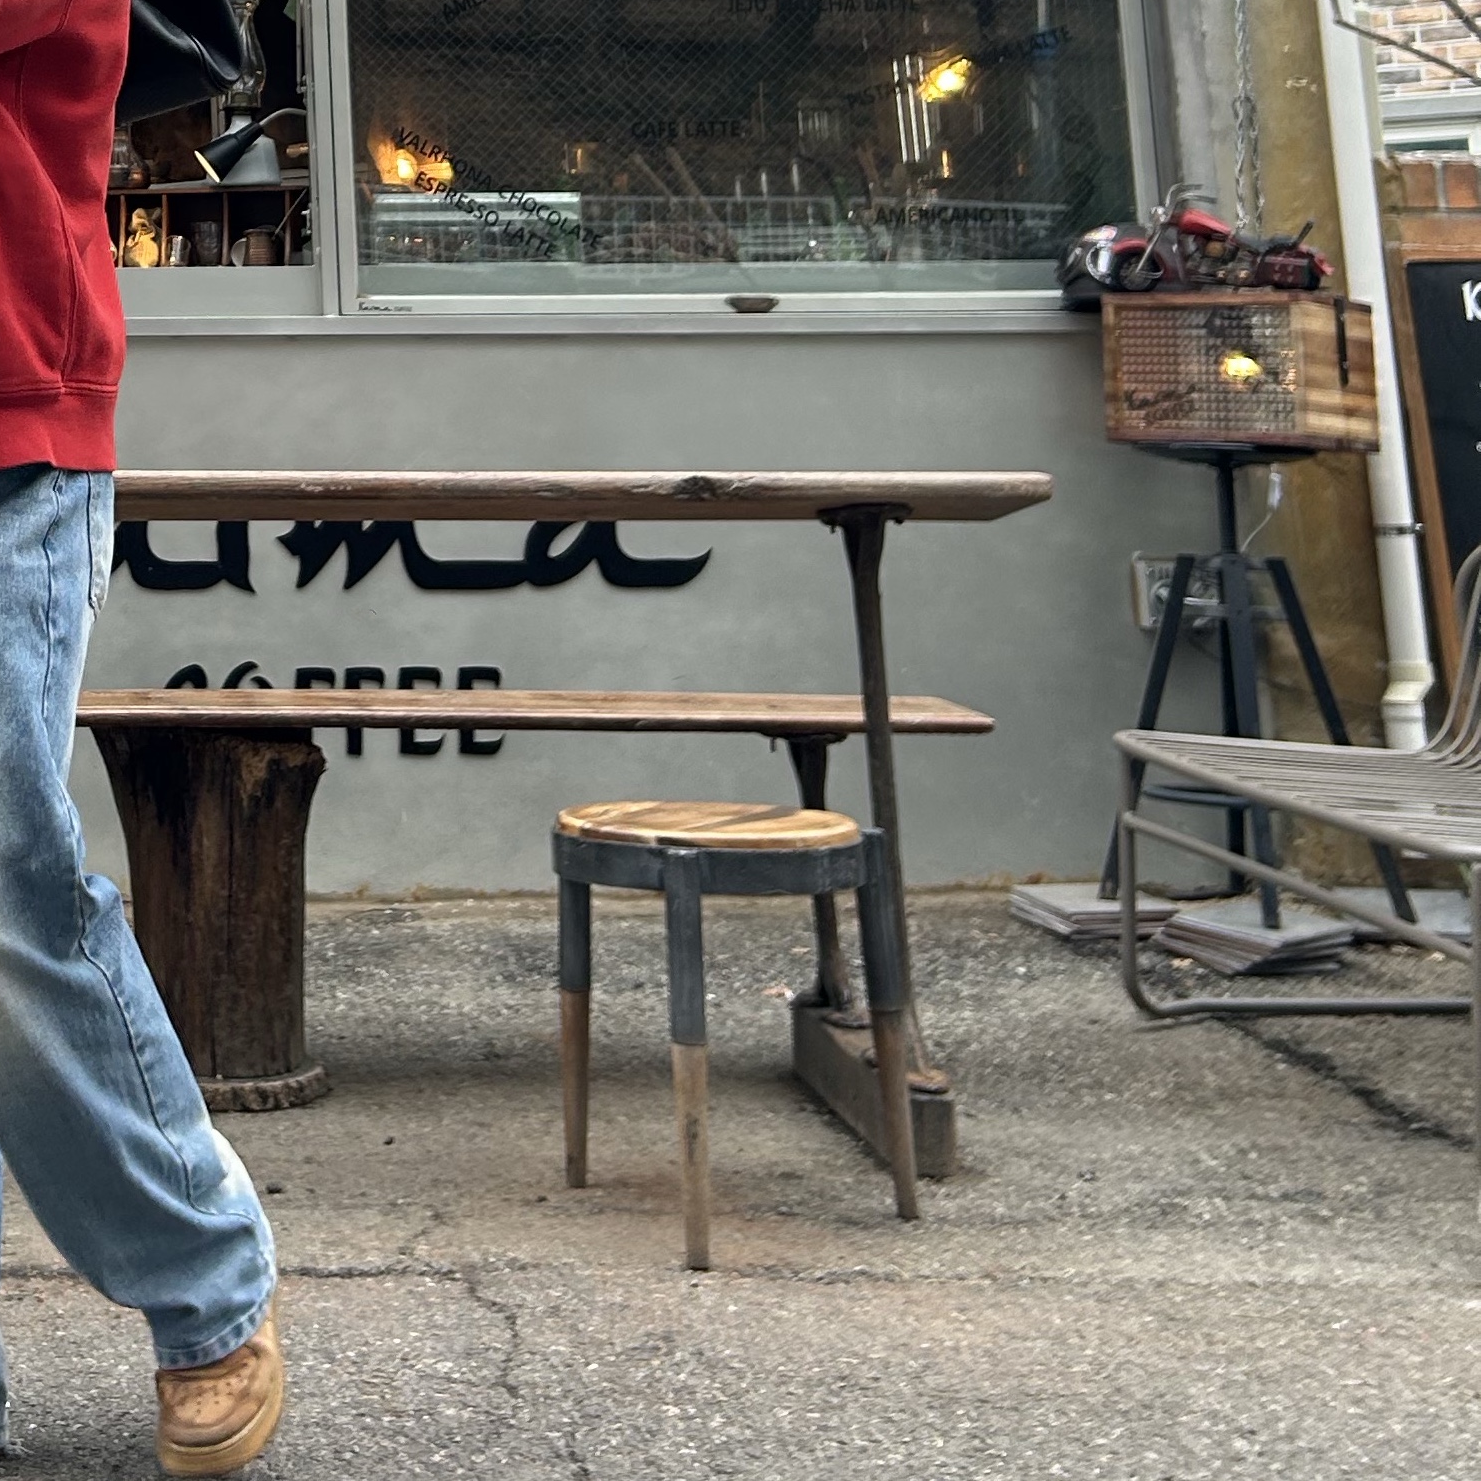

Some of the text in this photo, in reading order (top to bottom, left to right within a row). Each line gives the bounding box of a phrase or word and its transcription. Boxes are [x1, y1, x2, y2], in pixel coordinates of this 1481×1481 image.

[684, 120, 741, 138] LATTE
[415, 170, 559, 259] ESPRESSO LATTE
[498, 184, 604, 251] CHOCOLATE
